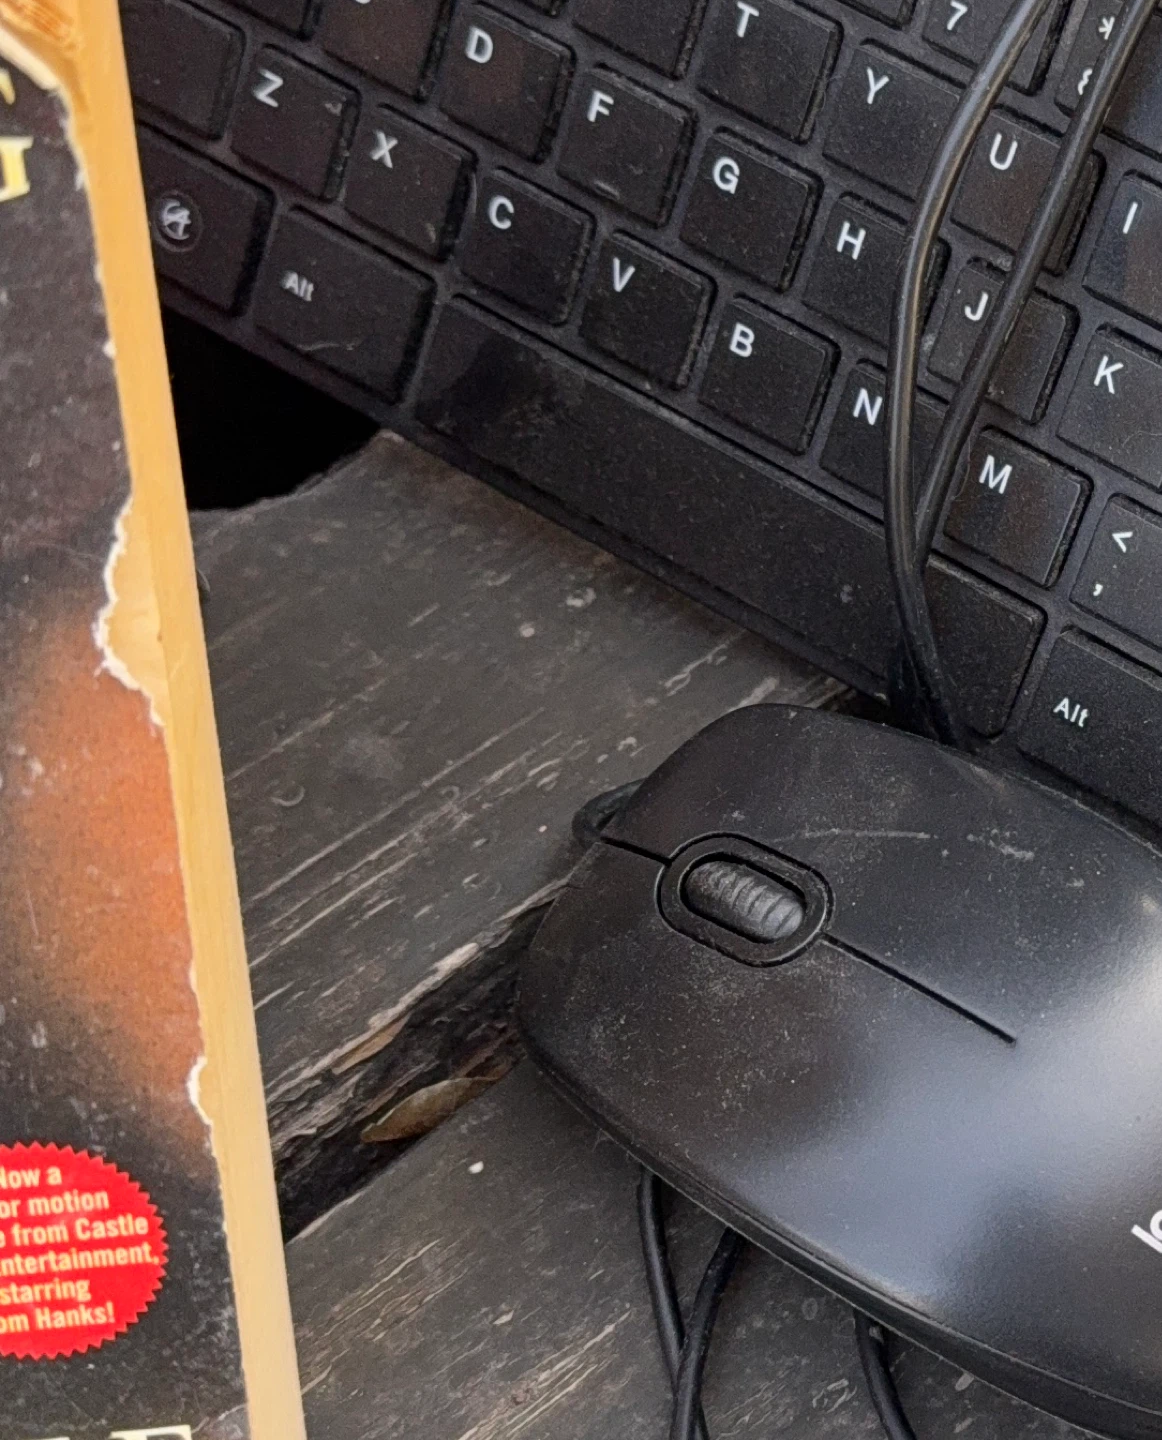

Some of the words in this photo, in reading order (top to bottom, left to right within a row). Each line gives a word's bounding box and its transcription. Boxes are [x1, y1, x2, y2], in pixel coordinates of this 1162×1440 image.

[737, 2, 759, 37] T
[947, 0, 967, 30] 7
[467, 28, 493, 63] D
[255, 71, 283, 107] Z
[867, 68, 889, 104] Y
[588, 91, 613, 122] F
[372, 132, 397, 168] X
[990, 134, 1017, 170] U
[713, 157, 739, 193] G
[489, 196, 514, 229] C
[837, 222, 866, 259] H
[286, 274, 313, 300] Alt
[613, 258, 635, 292] V
[965, 293, 988, 321] J
[730, 323, 754, 357] B
[1094, 356, 1123, 394] K
[853, 388, 882, 425] N
[979, 455, 1012, 494] M
[1113, 532, 1132, 552] <
[1054, 698, 1087, 726] Alt
[47, 1166, 62, 1186] a
[28, 1189, 109, 1216] motion
[12, 1221, 69, 1246] from
[75, 1213, 149, 1240] Castle
[0, 1241, 160, 1278] ntertainment,
[35, 1300, 115, 1330] Hanks!
